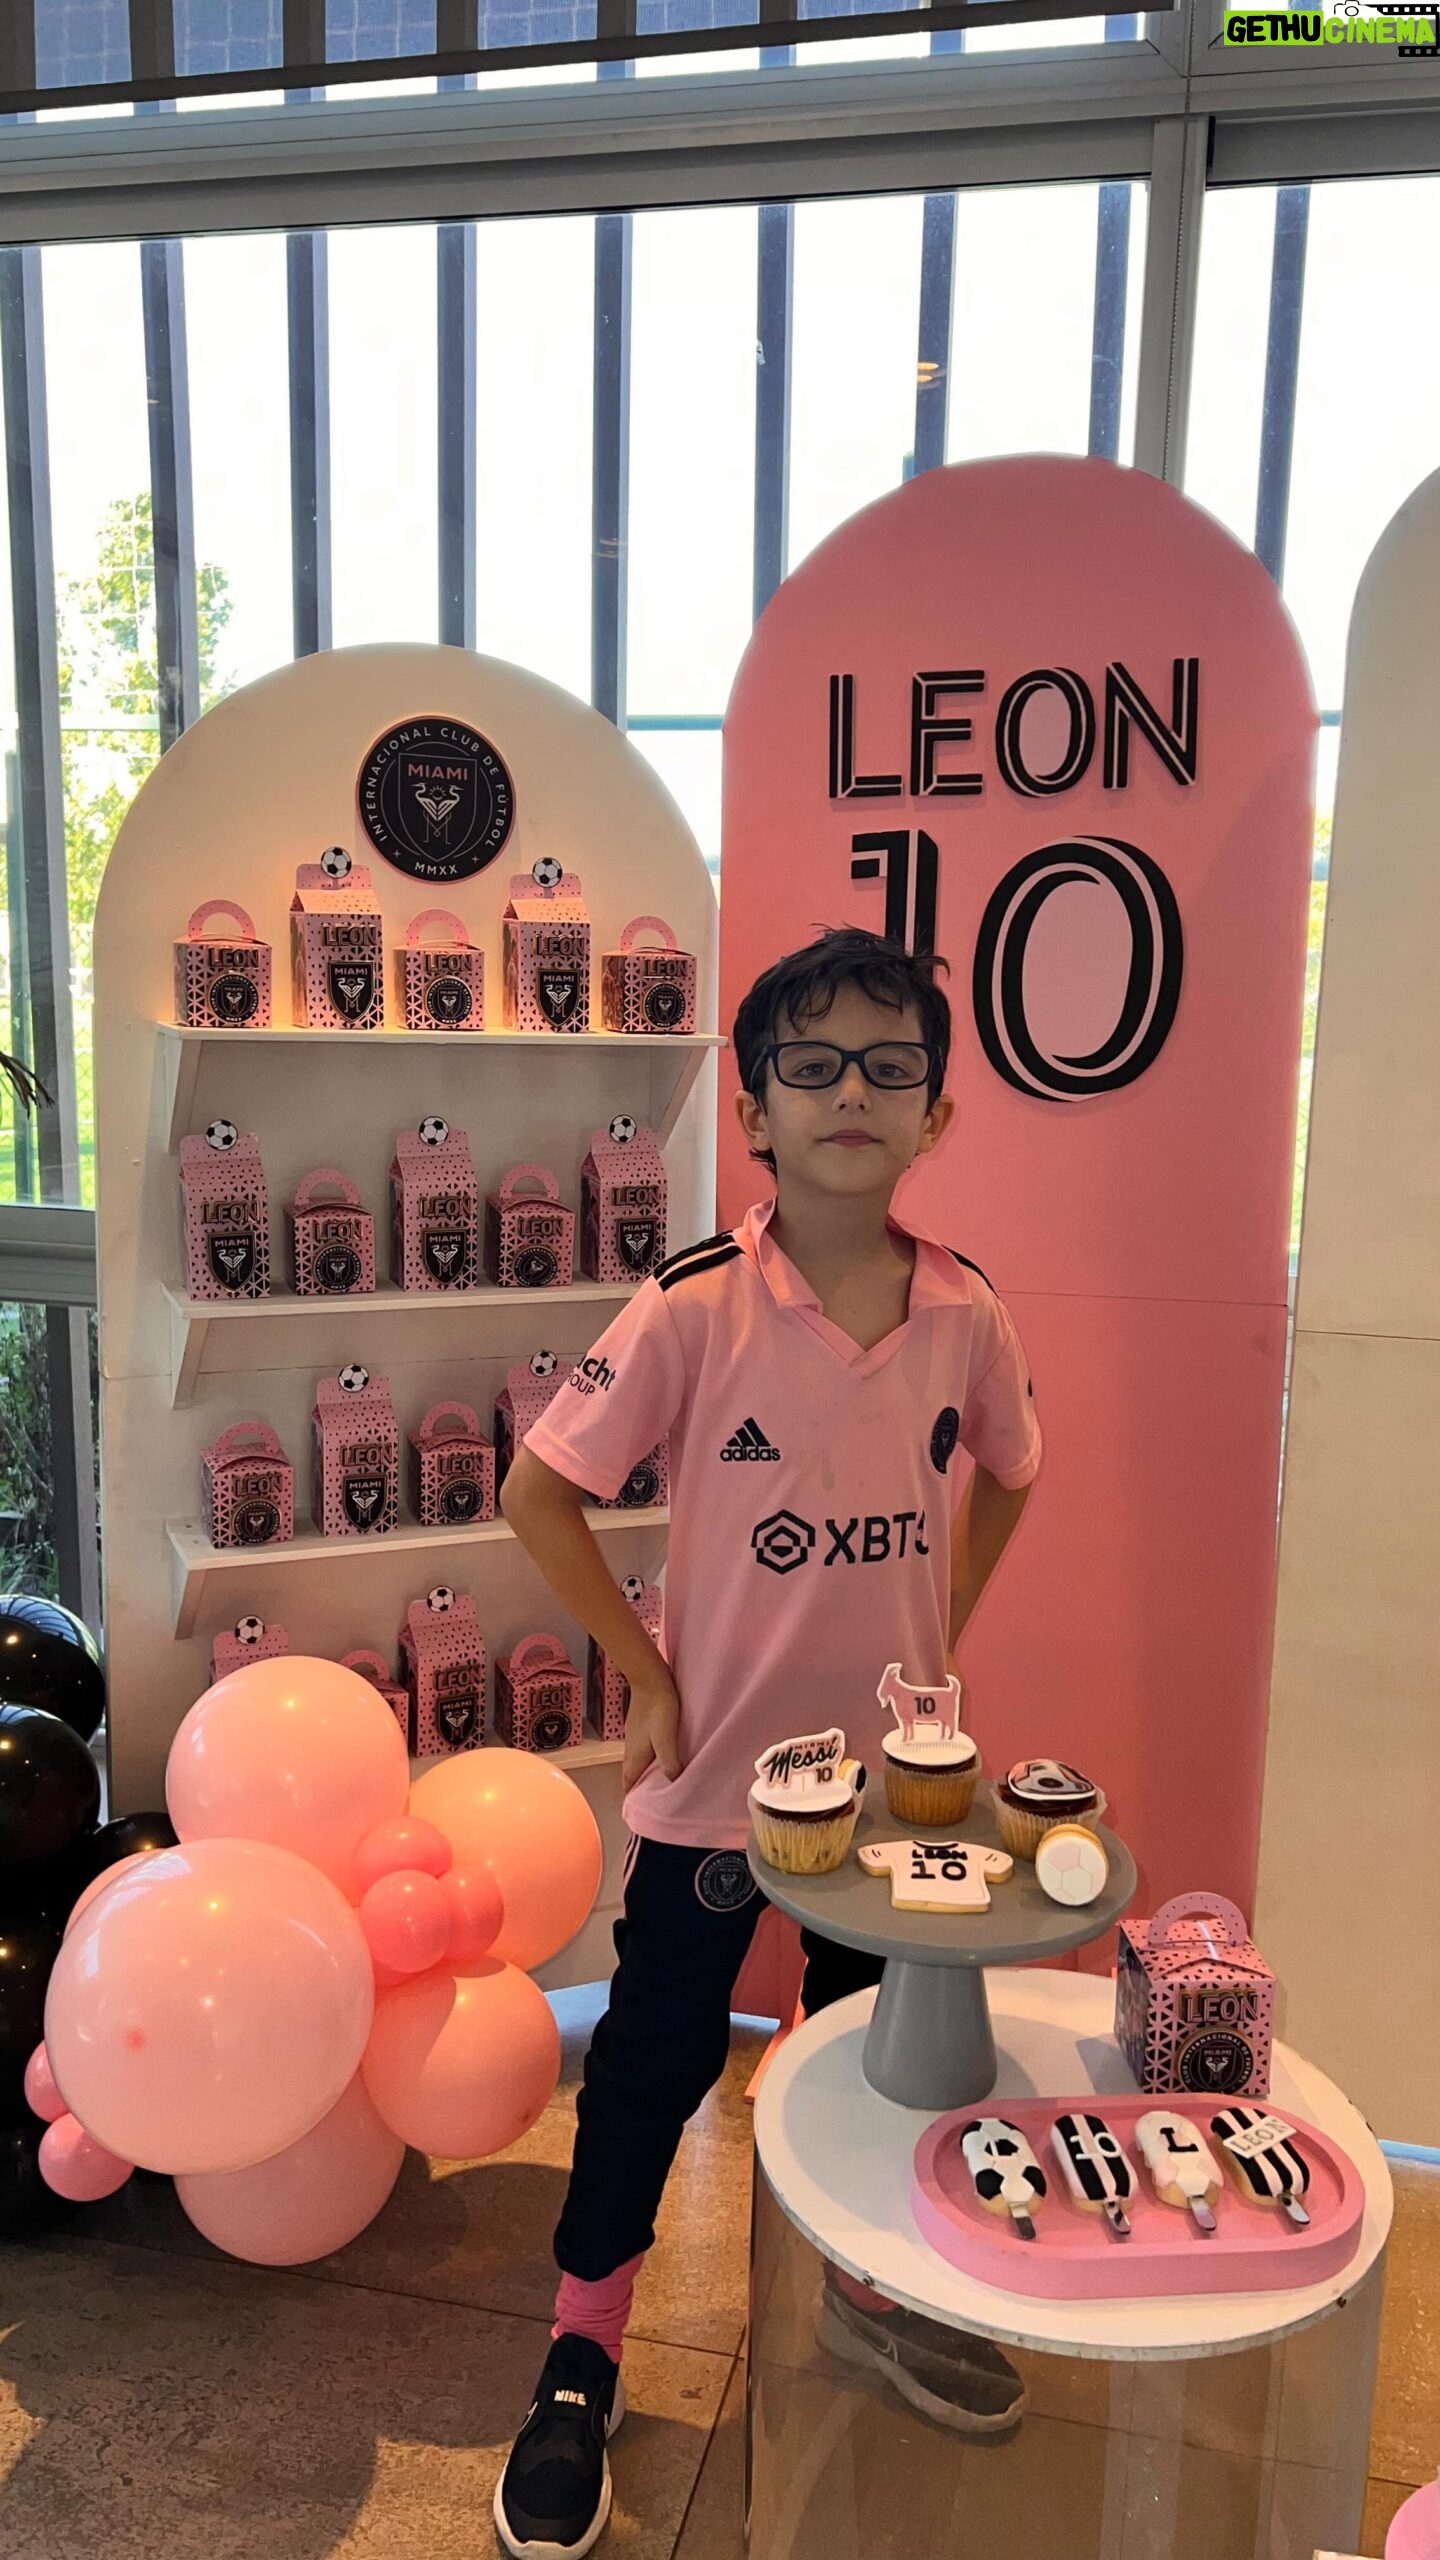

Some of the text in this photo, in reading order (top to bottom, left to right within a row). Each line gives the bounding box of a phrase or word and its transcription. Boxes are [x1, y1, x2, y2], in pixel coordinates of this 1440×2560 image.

[829, 657, 1199, 798] LEON
[408, 763, 468, 781] MIAMI
[366, 726, 431, 842] INTERNACIONAL
[440, 727, 480, 753] CLUB
[482, 756, 500, 776] DE
[414, 861, 458, 875] MMXX
[322, 924, 377, 947] LEON
[535, 935, 586, 956] LEON
[208, 947, 259, 968] LEON
[424, 953, 472, 973] LEON
[643, 959, 688, 977] LEON
[334, 967, 369, 976] MIAMI
[543, 974, 575, 983] MIAMI
[612, 1186, 661, 1206] LEON
[203, 1202, 260, 1223] LEON
[420, 1196, 471, 1218] LEON
[315, 1220, 364, 1241] LEON
[518, 1218, 563, 1238] LEON
[622, 1223, 652, 1232] MIAMI
[214, 1238, 250, 1248] MIAMI
[428, 1235, 462, 1243] MIAMI
[577, 1354, 616, 1391] cht
[341, 1444, 393, 1467] LEON
[438, 1453, 484, 1475] LEON
[720, 1447, 781, 1462] adidas
[234, 1474, 282, 1497] LEON
[349, 1481, 382, 1490] MIAMI
[434, 1665, 482, 1691] LEON
[443, 1700, 472, 1711] MIAMI
[914, 1696, 936, 1716] 10
[763, 1736, 838, 1784] Messi
[816, 1766, 833, 1784] 10
[911, 1860, 967, 1881] 10
[1184, 1993, 1258, 2024] LEON
[1160, 2127, 1199, 2152] L
[1231, 2117, 1290, 2152] LEON
[1070, 2132, 1122, 2160] 10
[554, 2389, 587, 2406] NIKE
